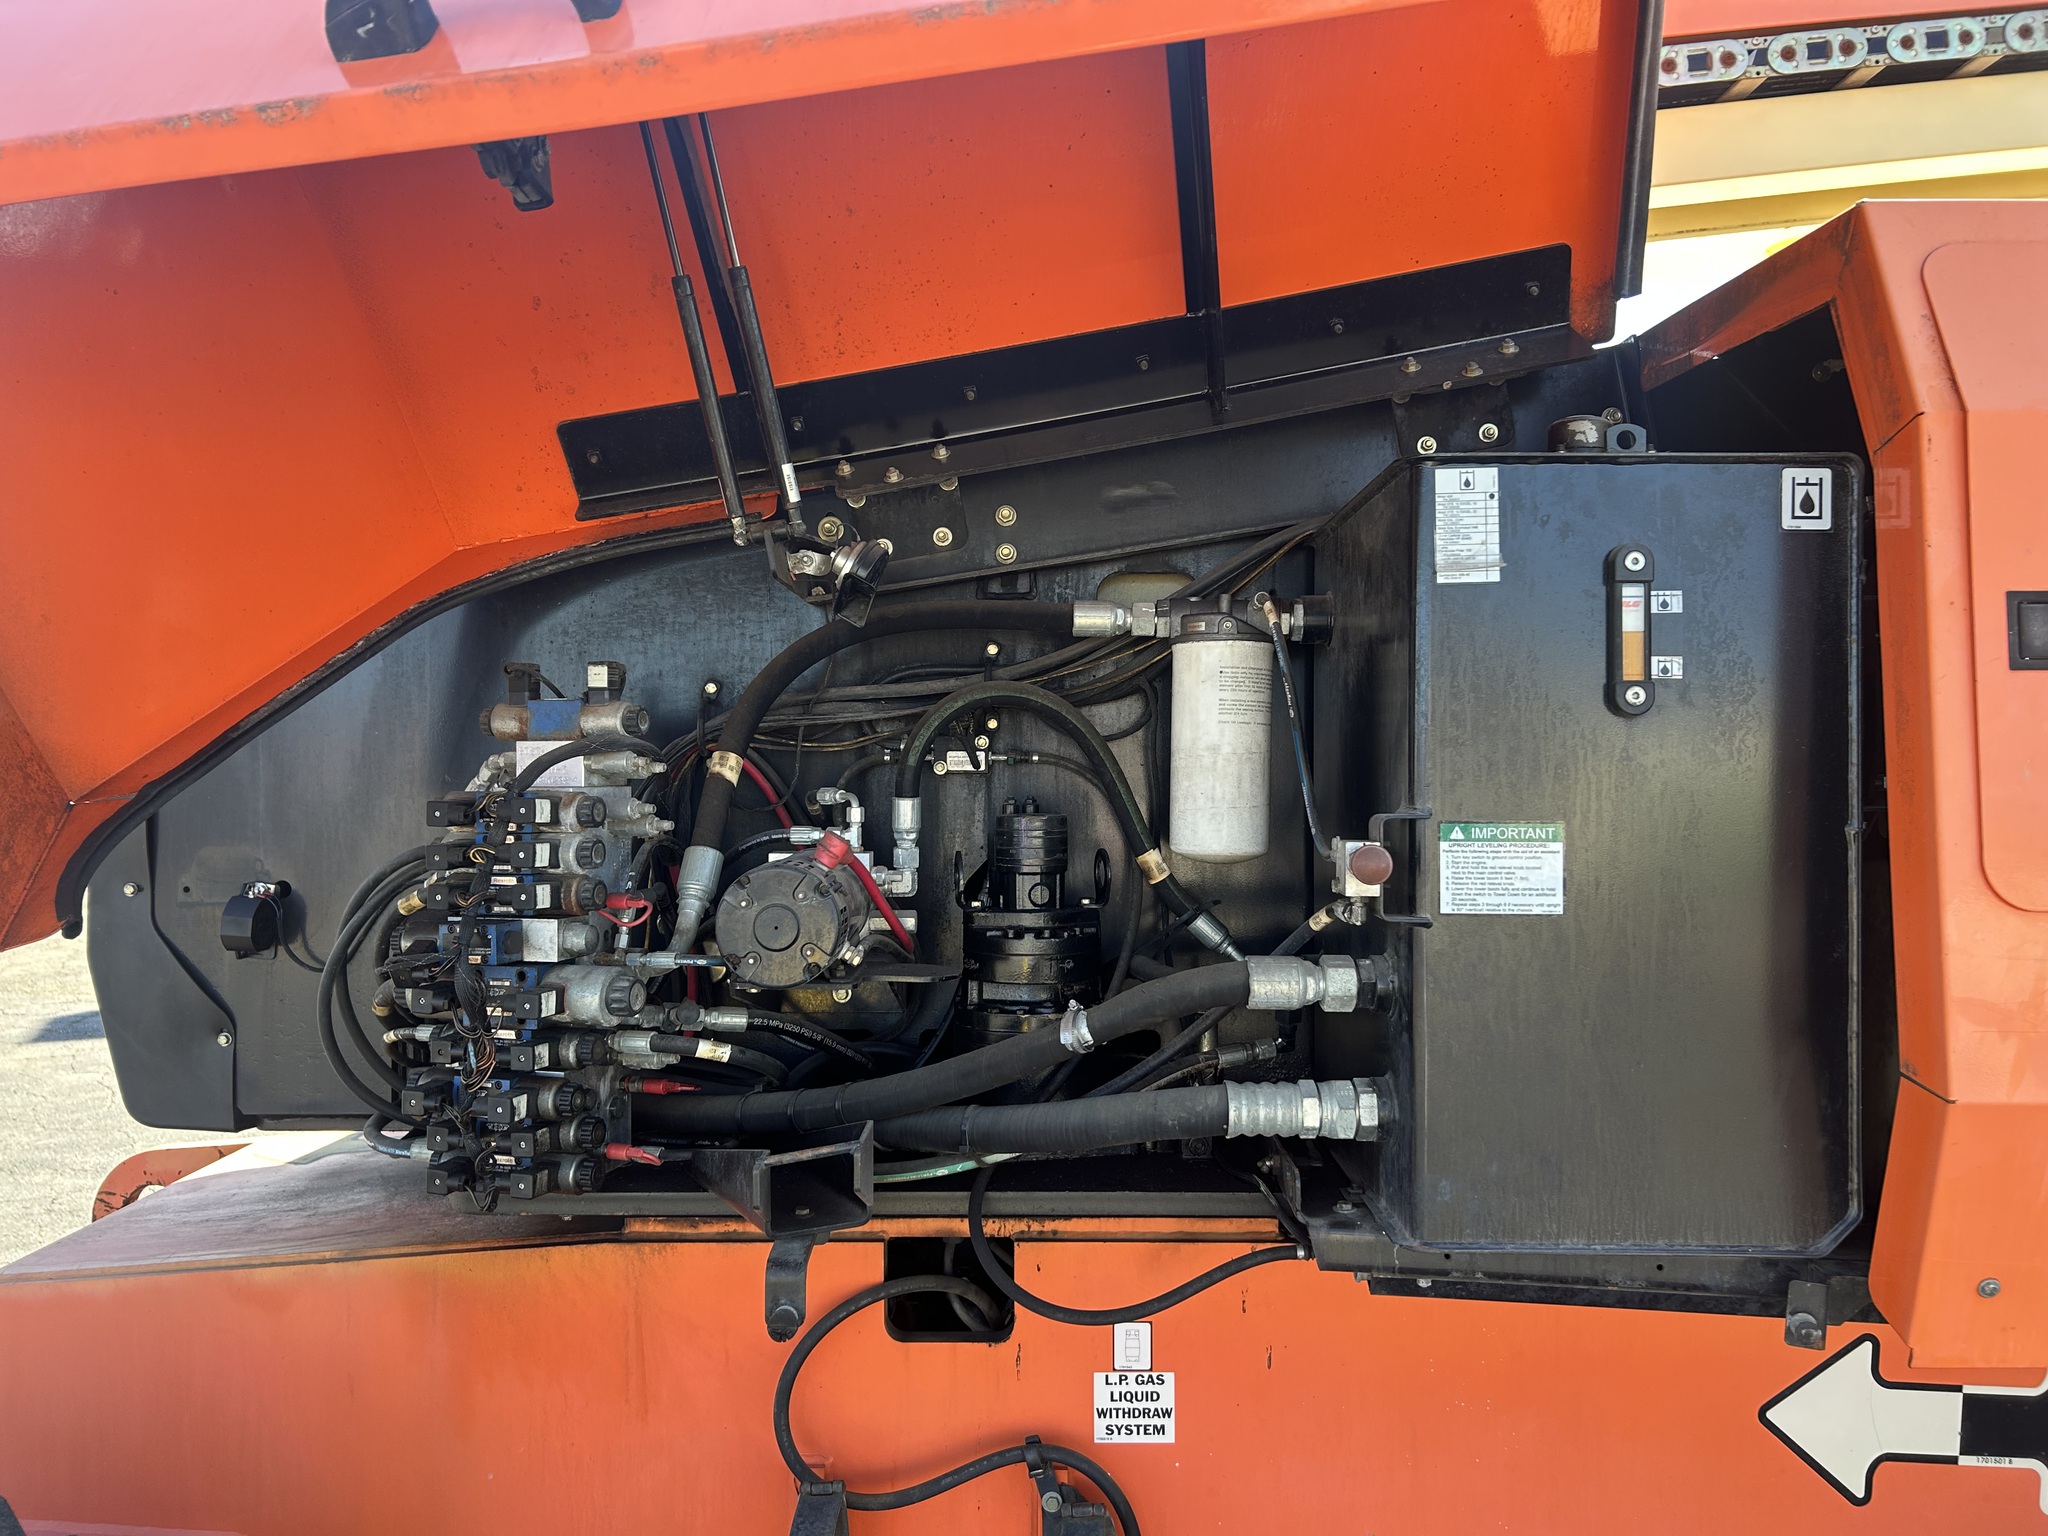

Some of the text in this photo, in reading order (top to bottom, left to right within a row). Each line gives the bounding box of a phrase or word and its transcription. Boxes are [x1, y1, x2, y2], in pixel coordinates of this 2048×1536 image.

[1471, 828, 1556, 839] IMPORTANT
[753, 1018, 768, 1026] 22.5
[769, 1020, 783, 1028] MPa
[784, 1022, 800, 1033] (3250
[1105, 1374, 1165, 1385] L.P. GAS
[1110, 1391, 1160, 1403] LIQUID
[1096, 1408, 1173, 1419] WITHDRAW
[1105, 1424, 1165, 1435] SYSTEM
